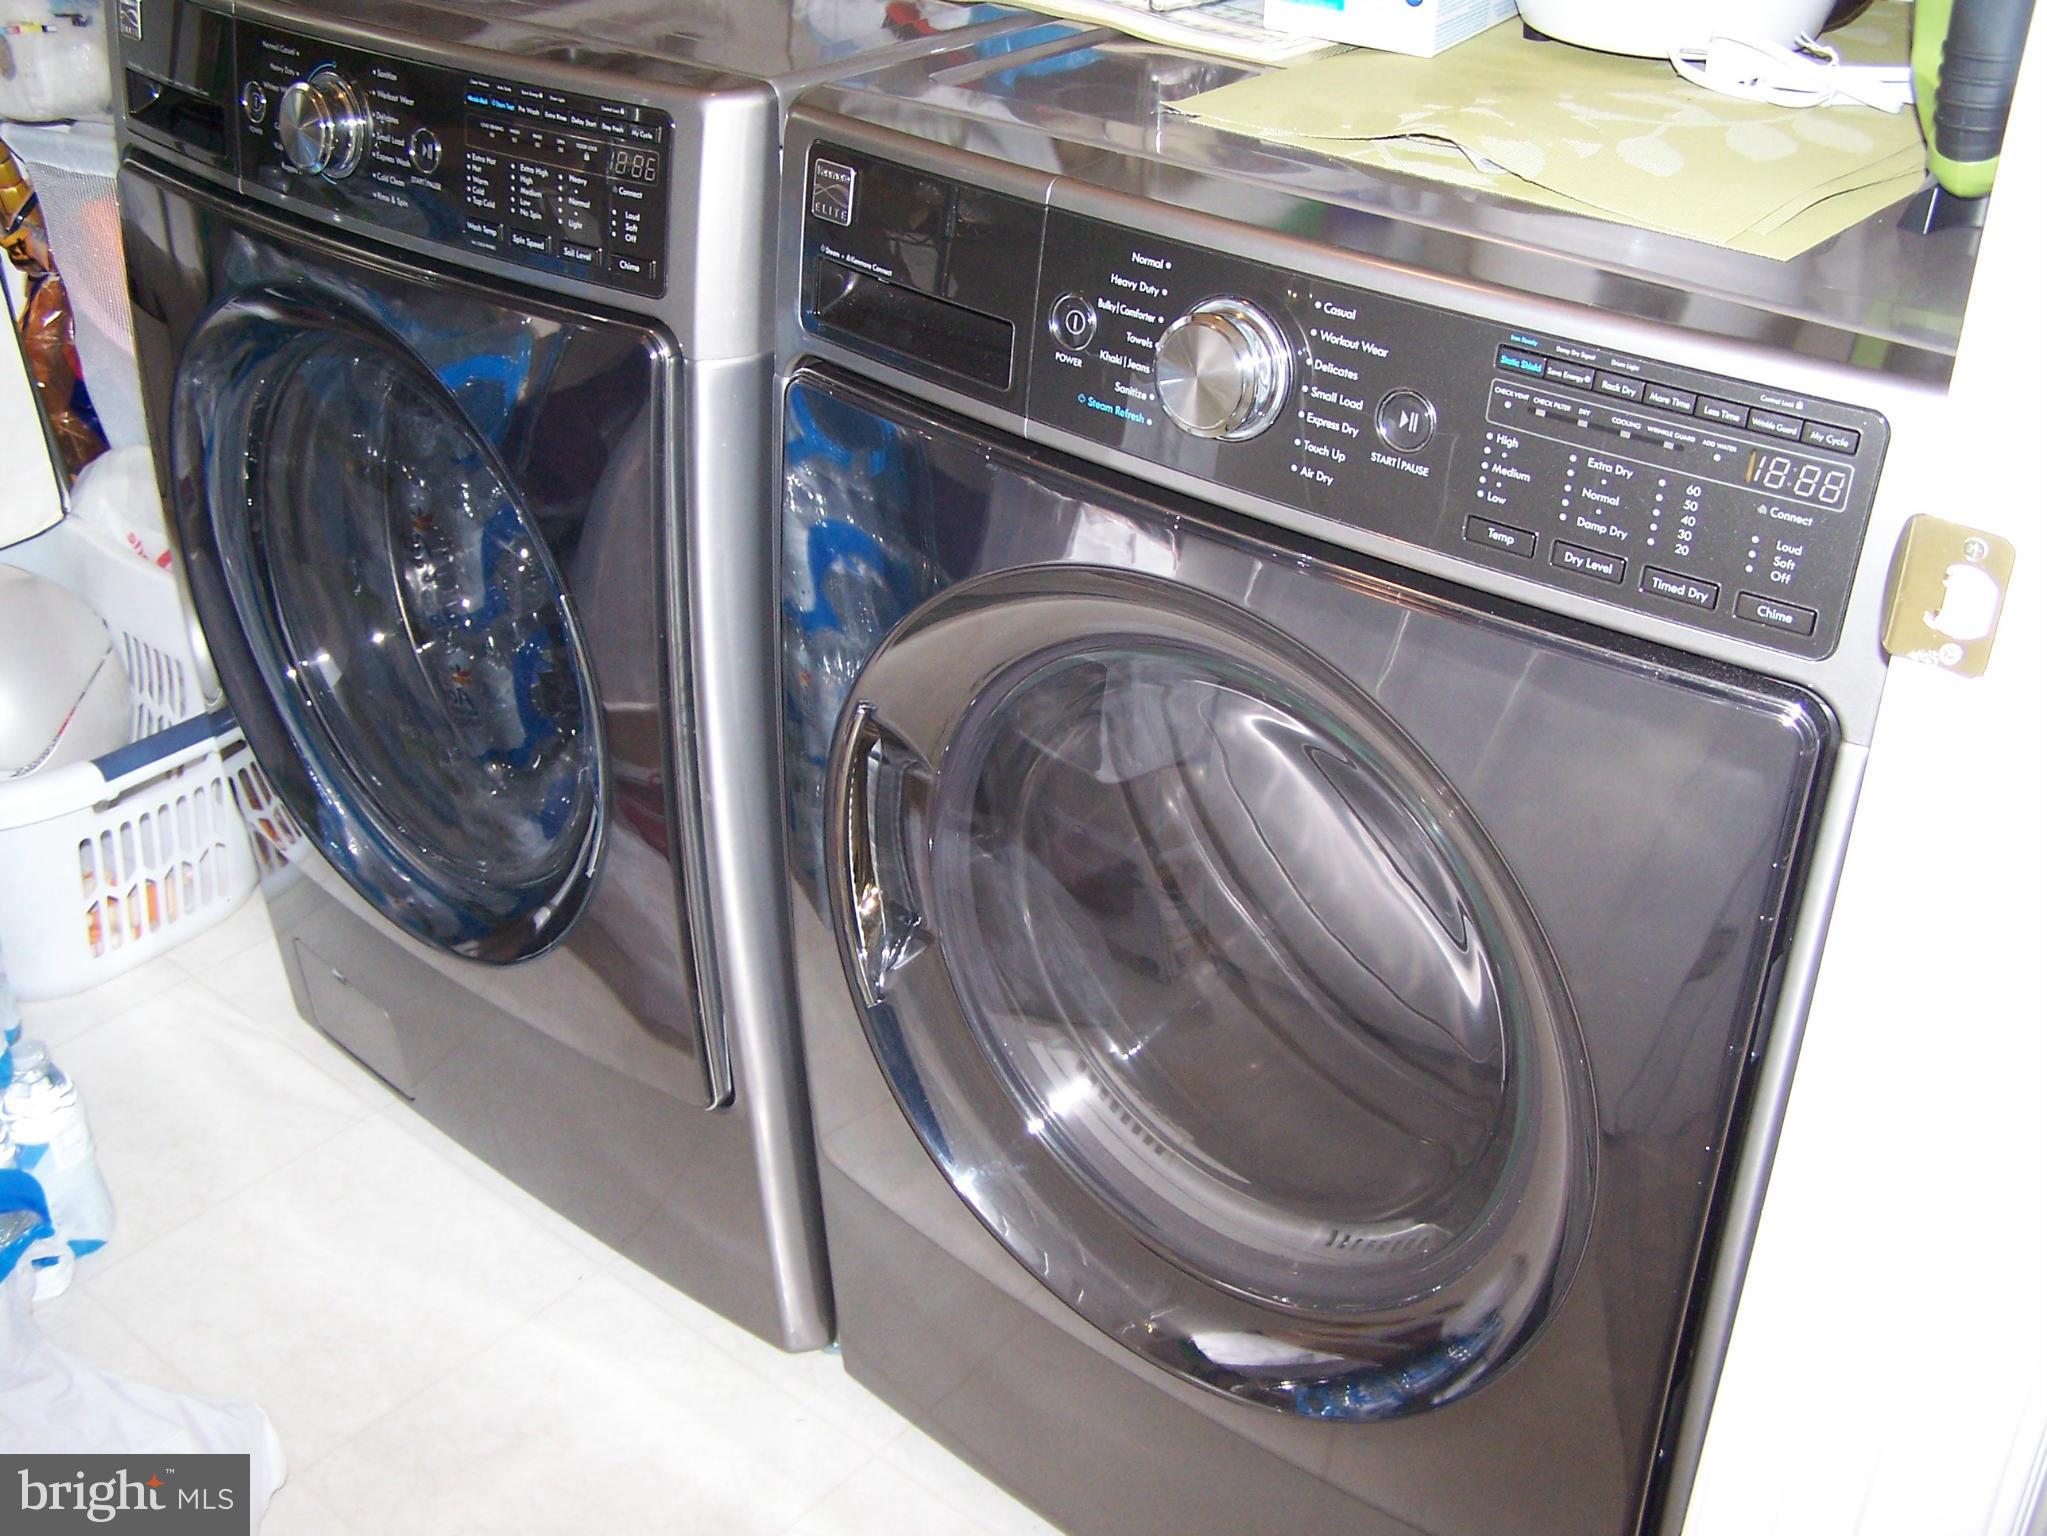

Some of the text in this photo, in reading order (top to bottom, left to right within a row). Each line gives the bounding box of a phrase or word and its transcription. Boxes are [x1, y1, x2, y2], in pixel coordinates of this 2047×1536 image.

[526, 106, 540, 116] Wash
[571, 115, 597, 128] Delay Start
[631, 128, 653, 140] My Cycle
[472, 152, 496, 166] Extra Hot
[472, 163, 483, 173] Hot
[520, 163, 549, 178] Extra High
[472, 175, 489, 187] Warm
[520, 174, 534, 186] High
[568, 174, 588, 187] Heavy
[472, 185, 485, 197] Cold
[520, 186, 543, 199] Medium
[618, 186, 643, 200] Connect
[472, 195, 496, 209] Tap Cold
[520, 196, 531, 207] Low
[568, 197, 591, 209] Normal
[520, 207, 542, 220] No Spin
[625, 210, 640, 222] Loud
[815, 202, 848, 221] ELITE
[466, 221, 497, 237] Wash Temp
[568, 219, 583, 230] Light
[625, 222, 638, 233] Soft
[512, 233, 544, 250] Spin Speed
[624, 233, 637, 244] Off
[563, 246, 592, 262] Soil Level
[1131, 251, 1164, 270] Normal
[619, 259, 640, 273] Chime
[1110, 273, 1160, 298] Heavy Duty
[1323, 302, 1357, 321] Casual
[1126, 331, 1153, 349] Towels
[1320, 329, 1389, 358] Workout Wear
[1055, 351, 1083, 368] POWER
[1555, 345, 1571, 356] Damp
[1571, 348, 1581, 359] Dry
[1314, 359, 1359, 381] Delicates
[1500, 354, 1543, 374] Static Shield
[1626, 362, 1641, 373] Light
[1547, 366, 1585, 385] Save Energy
[1114, 381, 1147, 400] Sanitize
[1494, 385, 1530, 402] CHECK VENT
[1601, 380, 1637, 399] Rack Dry
[1310, 386, 1364, 411] Small Load
[1533, 396, 1572, 412] CHECK FILTER
[1649, 391, 1691, 411] More Time
[1760, 394, 1782, 406] Control
[1087, 396, 1145, 424] Steam Refresh
[1578, 407, 1592, 417] DRY
[1703, 405, 1741, 423] Less Time
[1306, 411, 1359, 439] Express Dry
[1611, 415, 1642, 430] COOLING
[1751, 416, 1798, 437] Wrinkle Guard
[1496, 433, 1519, 449] High
[1647, 425, 1696, 443] WRINKLE GUARD
[1810, 430, 1849, 449] My Cycle
[1303, 439, 1346, 464] Touch Up
[1702, 438, 1737, 454] ADD WATER
[1299, 465, 1334, 486] Air Dry
[1491, 463, 1531, 483] Medium
[1587, 456, 1634, 480] Extra Dry
[1487, 491, 1507, 505] Low
[1581, 487, 1621, 507] Normal
[1686, 484, 1702, 498] 60
[1683, 499, 1698, 513] 50
[1680, 514, 1696, 528] 40
[1769, 507, 1813, 527] Connect
[1488, 527, 1515, 546] Temp
[1576, 516, 1628, 541] Damp Dry
[1677, 529, 1692, 542] 30
[1674, 543, 1690, 556] 20
[1776, 540, 1803, 556] Loud
[1564, 551, 1613, 575] Dry Level
[1773, 555, 1796, 571] Soft
[1770, 570, 1791, 585] Off
[1652, 576, 1709, 604] Timed Dry
[1756, 605, 1793, 625] Chime
